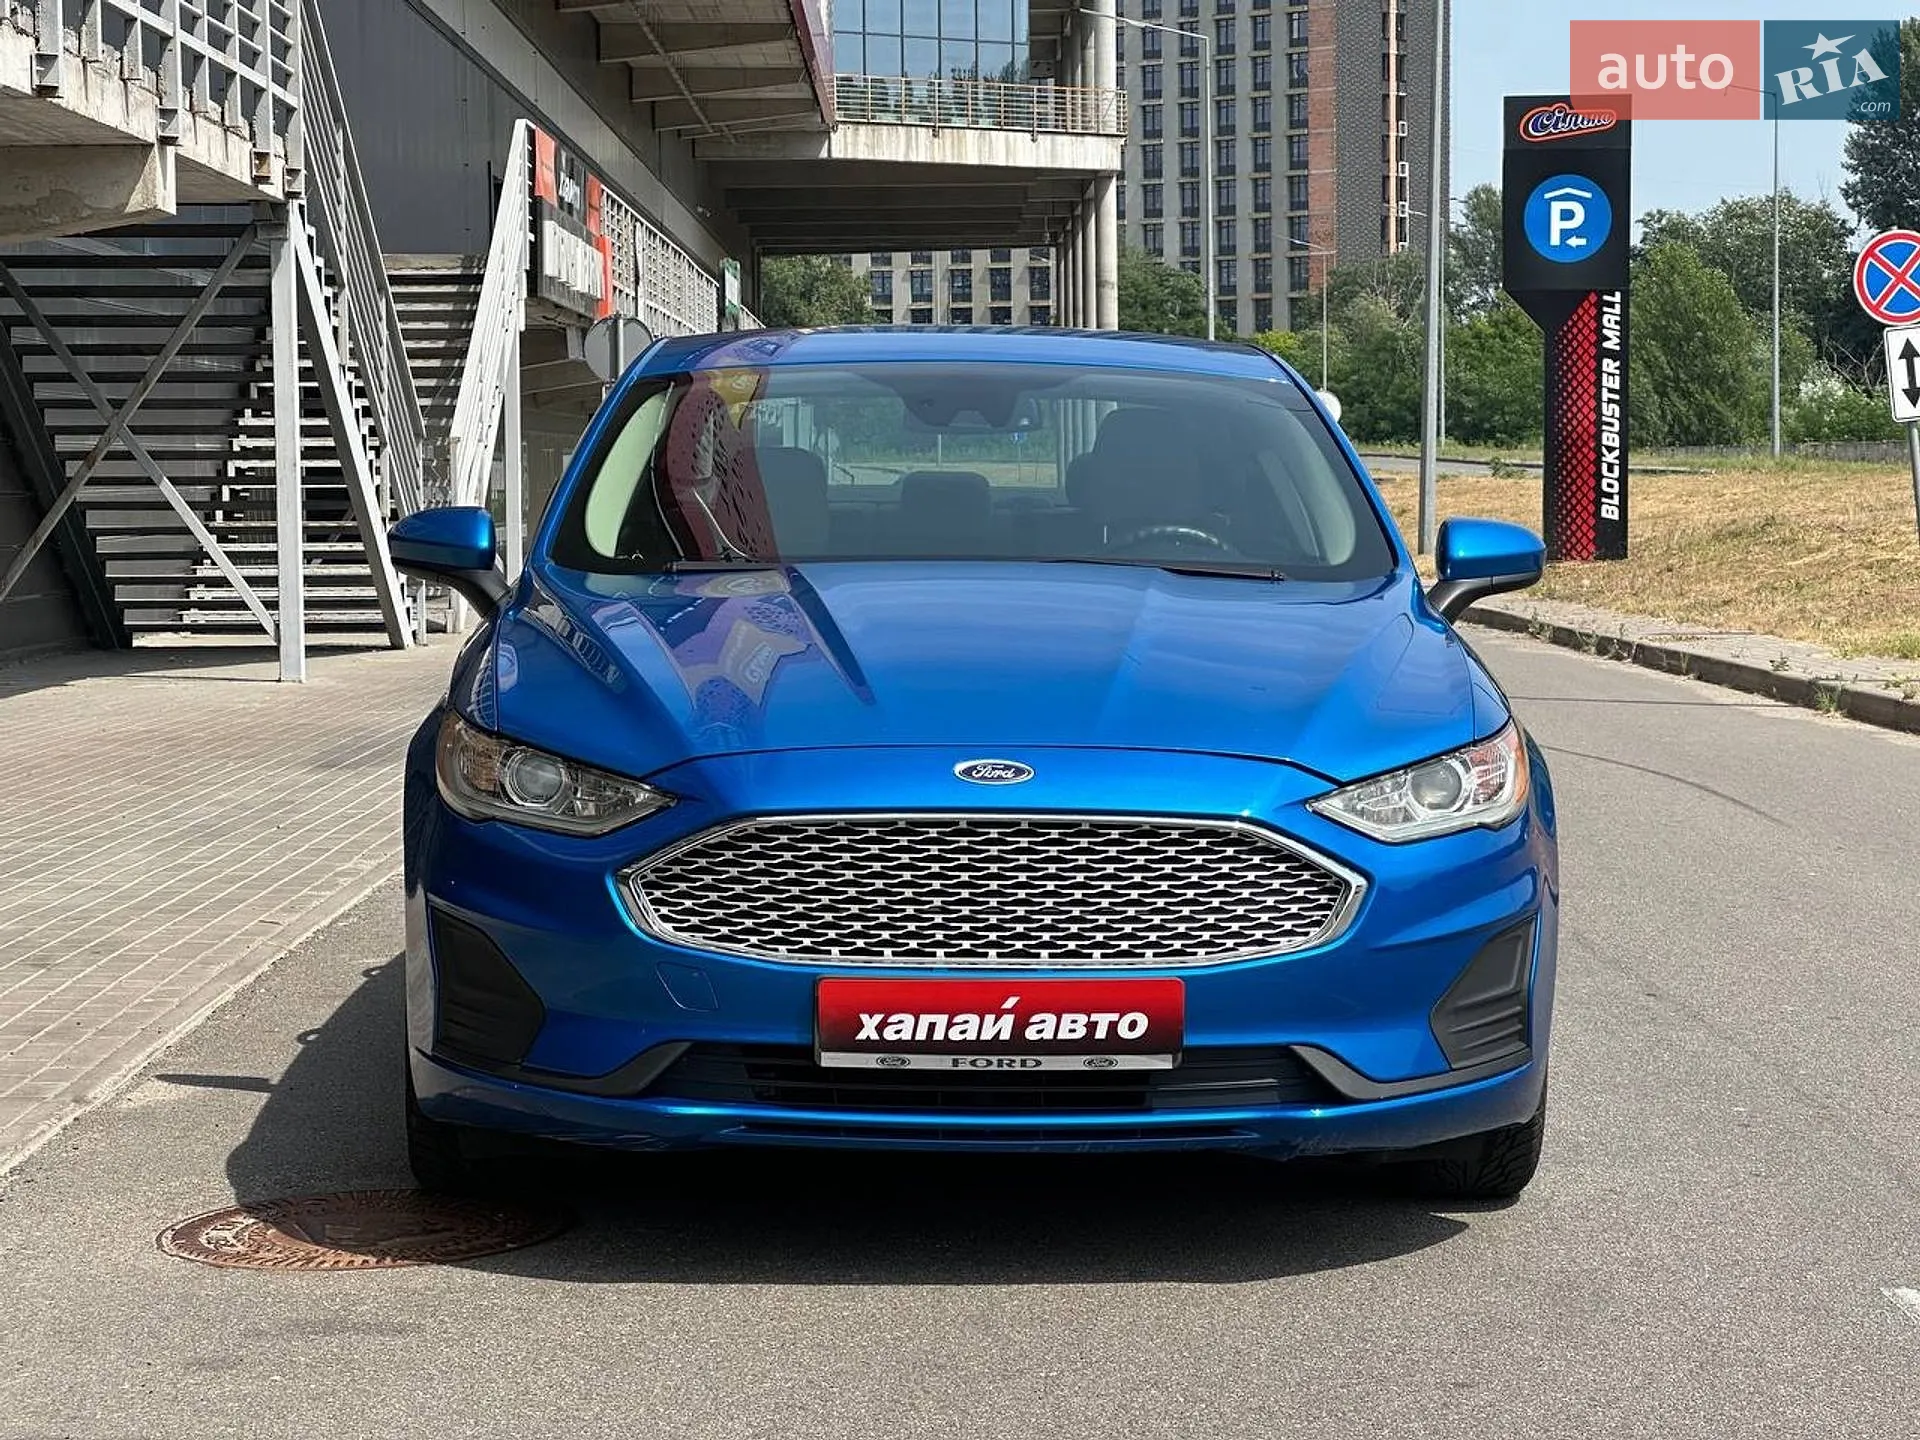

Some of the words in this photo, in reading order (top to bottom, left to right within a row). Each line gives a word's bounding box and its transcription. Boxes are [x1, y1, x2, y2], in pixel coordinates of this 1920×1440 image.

[1550, 201, 1585, 246] P
[1602, 290, 1621, 350] MALL
[1601, 357, 1621, 520] BLOCKBUSTER
[1024, 1012, 1149, 1040] авто
[951, 1056, 1043, 1069] FORD
